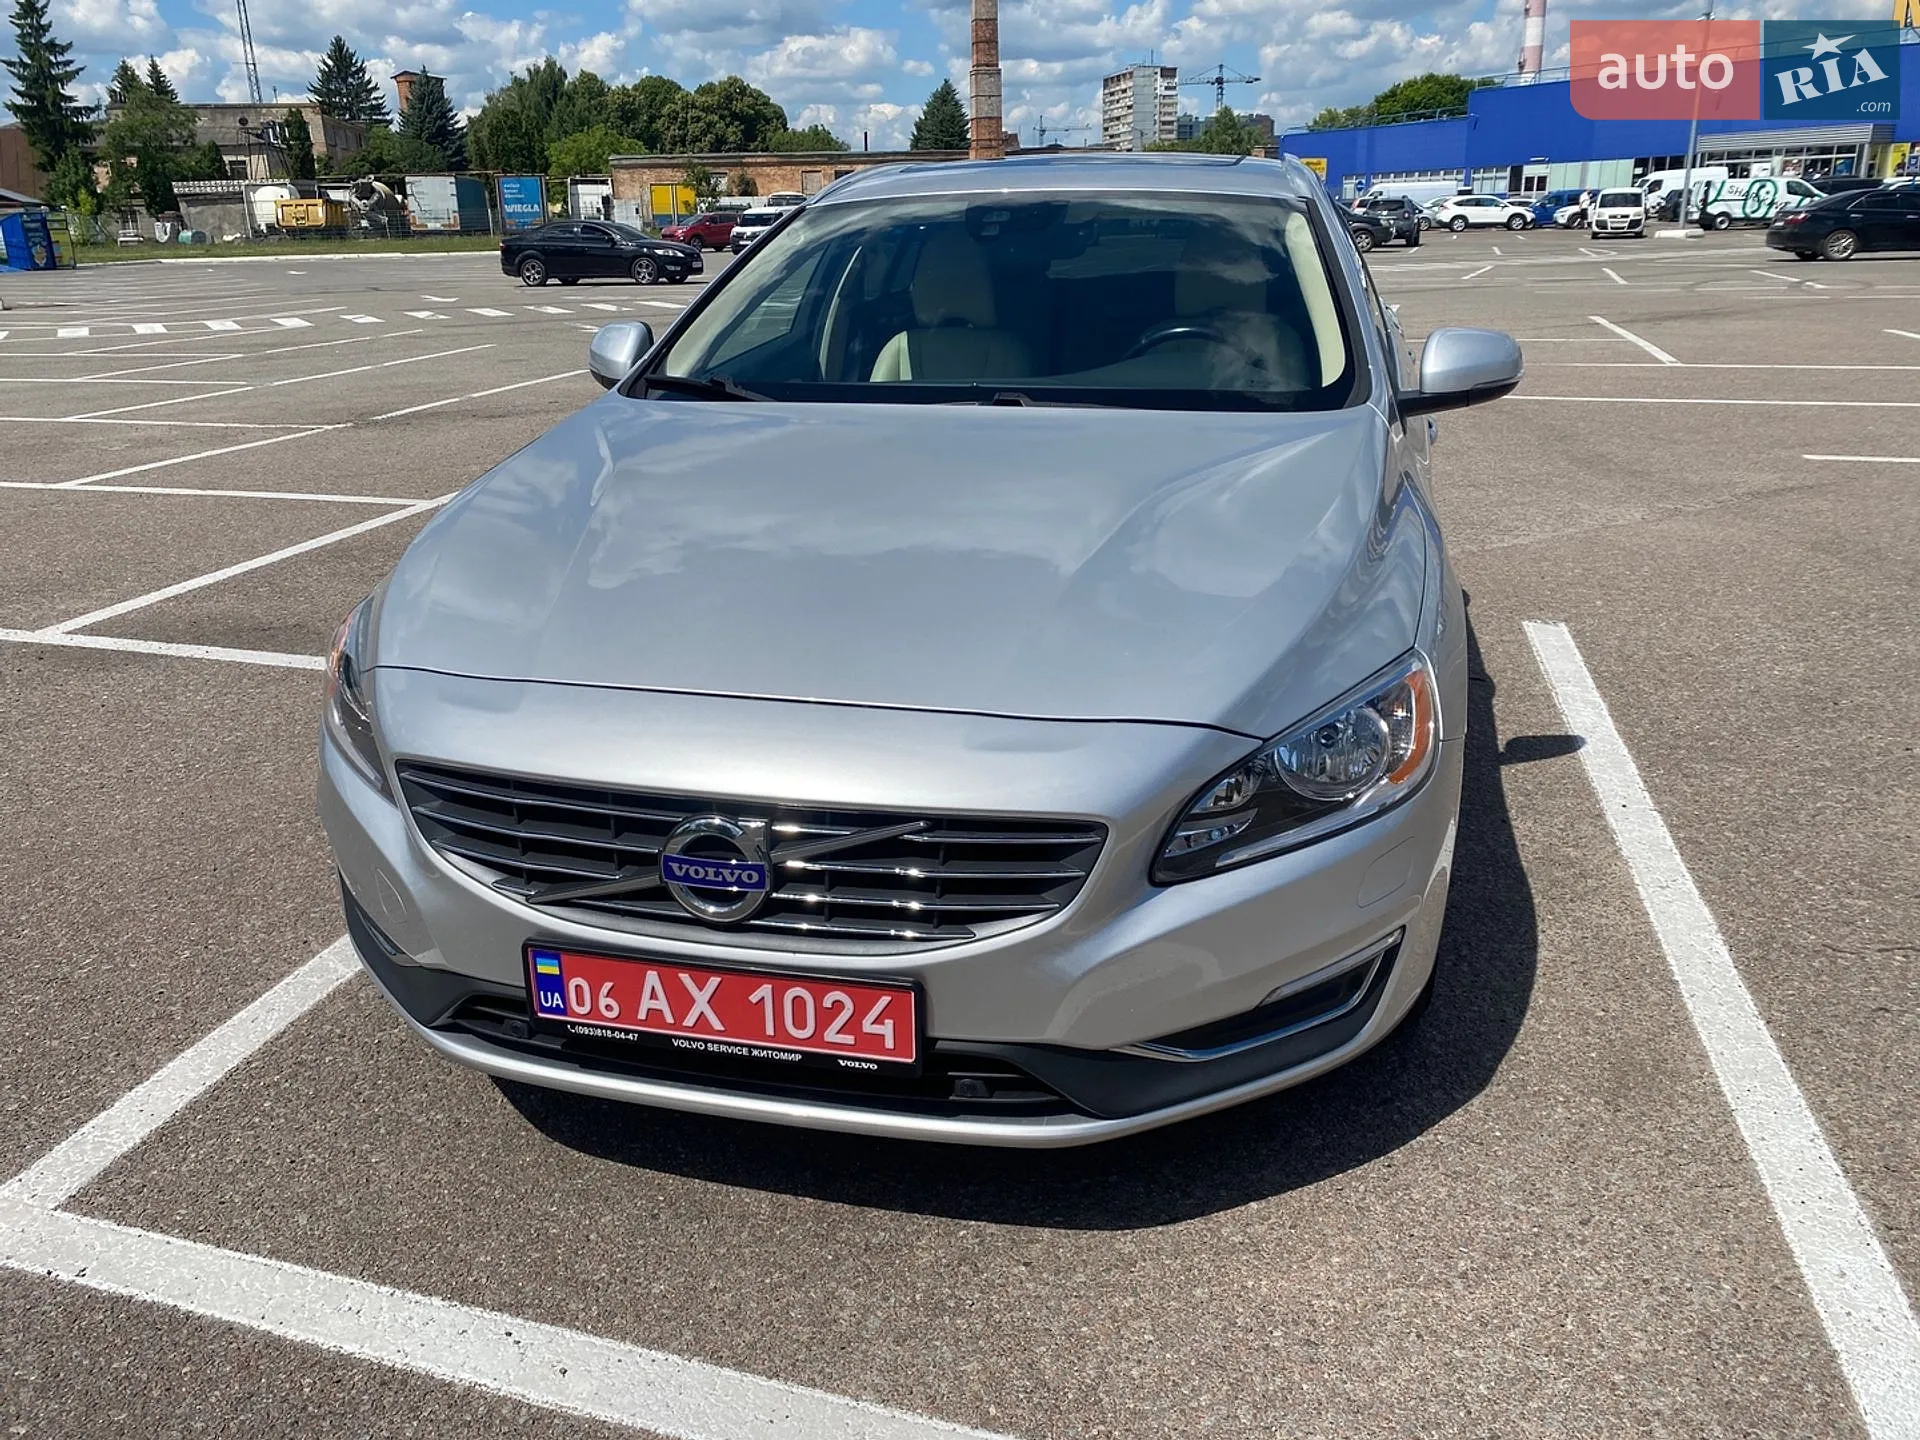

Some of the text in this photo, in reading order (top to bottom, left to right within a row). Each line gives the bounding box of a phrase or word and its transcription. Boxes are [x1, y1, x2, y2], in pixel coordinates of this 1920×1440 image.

[668, 861, 760, 884] VOLVO
[539, 990, 564, 1009] UA
[568, 970, 895, 1050] 06 AX 1024
[671, 1038, 802, 1062] VOLVO SERVICE ЖИТОМИР
[837, 1058, 878, 1070] VOLVO
